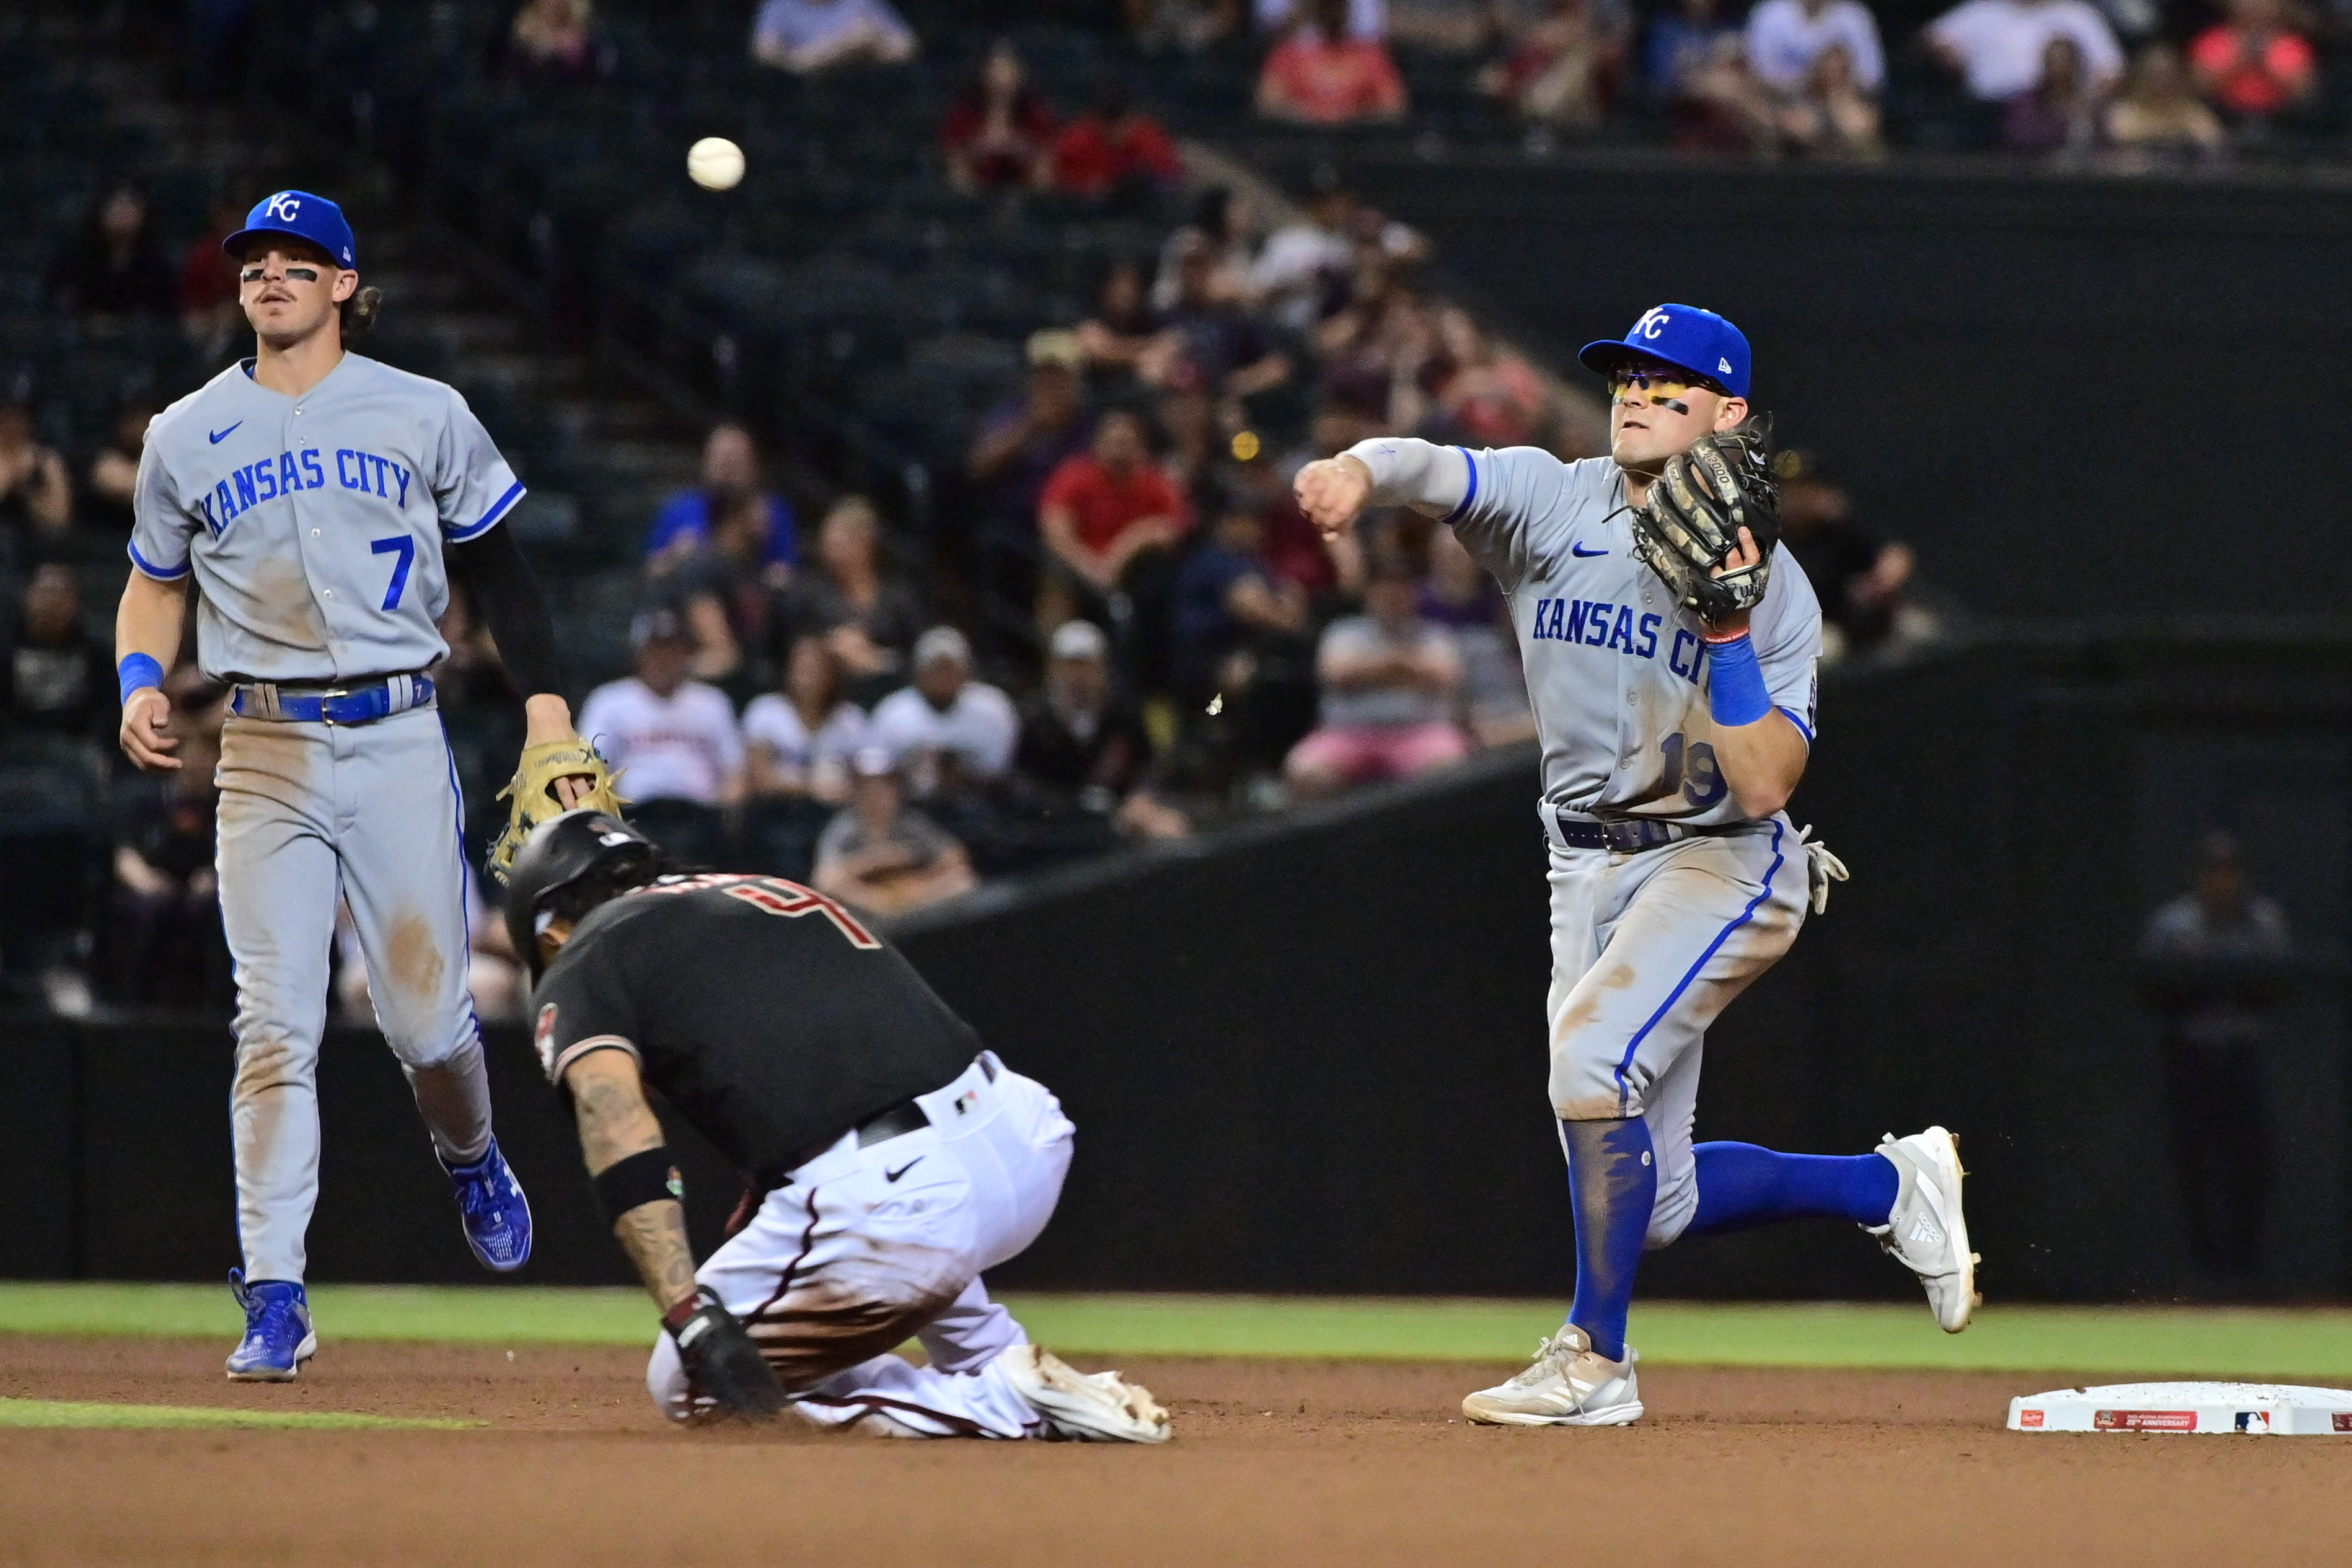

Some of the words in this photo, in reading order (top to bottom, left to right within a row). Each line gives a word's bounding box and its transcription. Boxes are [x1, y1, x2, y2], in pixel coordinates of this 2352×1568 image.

[266, 193, 299, 222] KC
[1633, 307, 1670, 339] KC
[1704, 451, 1729, 483] A2000
[201, 449, 325, 539] KANSAS
[336, 449, 410, 509] CITY
[371, 534, 415, 610] 7
[1533, 598, 1662, 659] KANSAS
[1670, 628, 1710, 689] CI
[415, 684, 423, 699] 7
[1659, 732, 1728, 806] 19
[722, 876, 883, 949] 4
[1918, 1211, 1941, 1241] adidas
